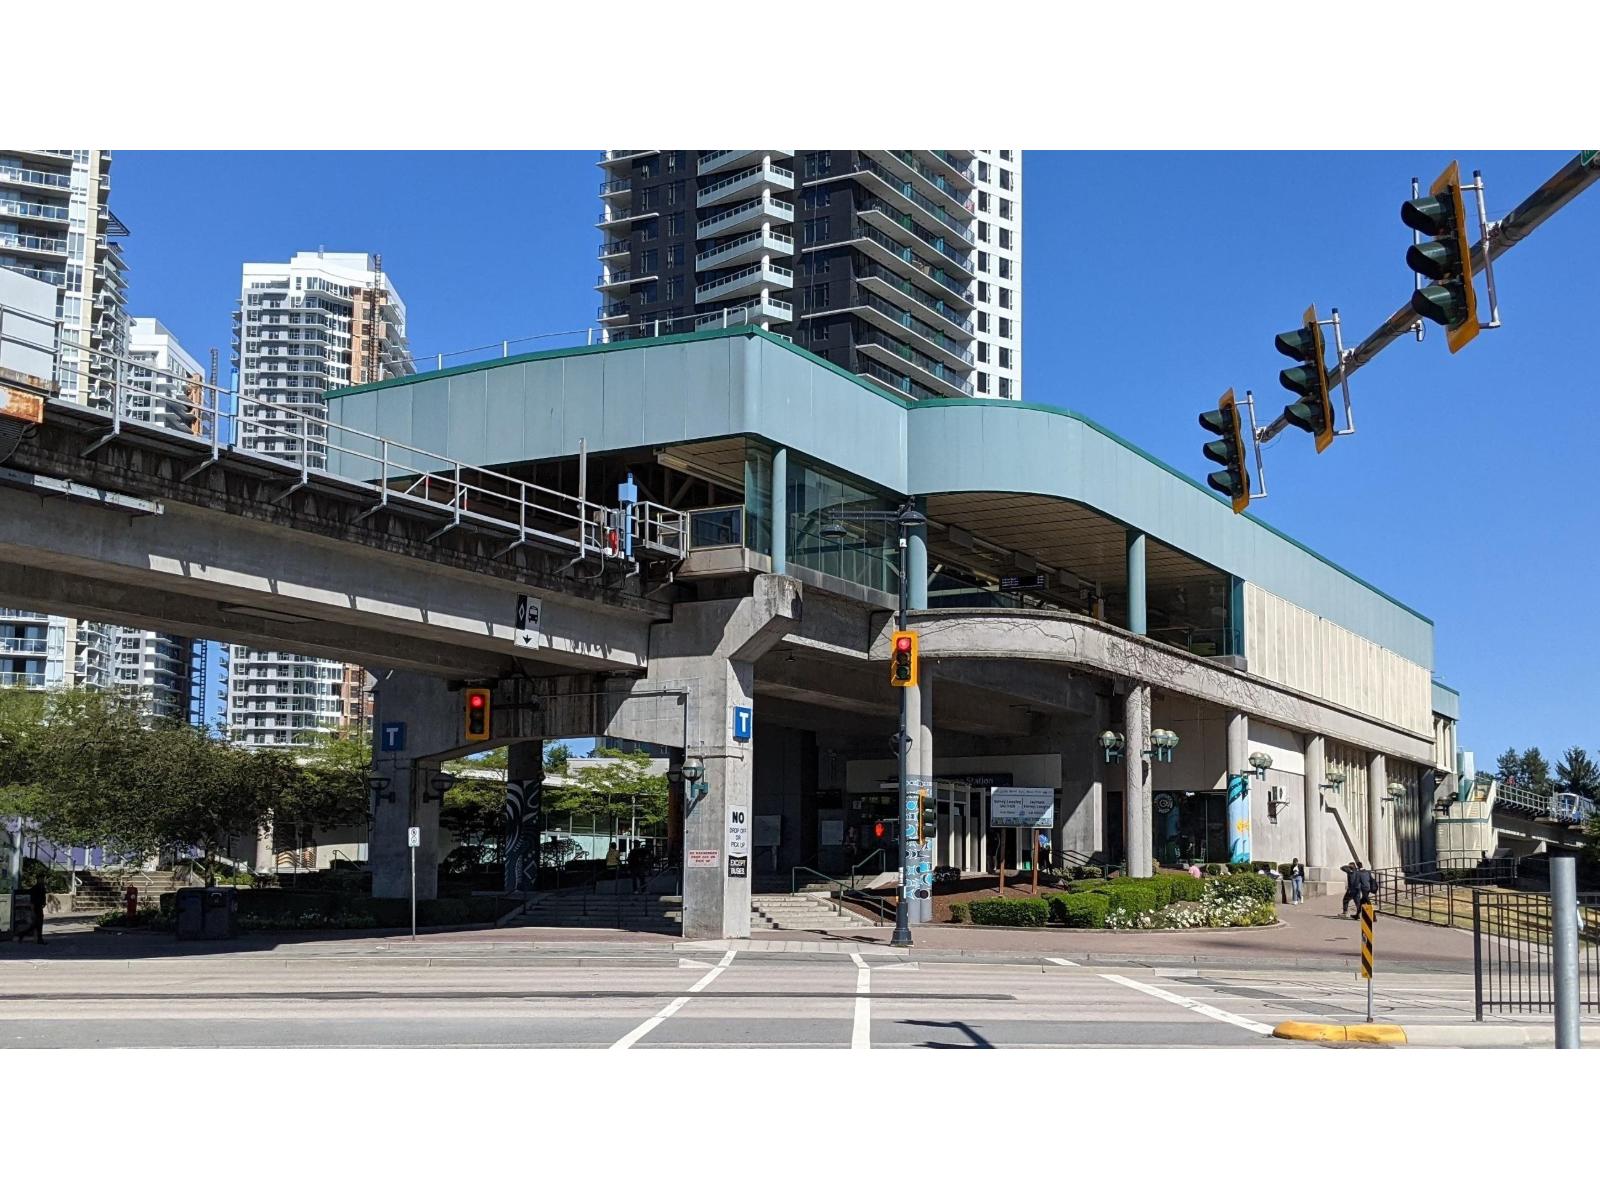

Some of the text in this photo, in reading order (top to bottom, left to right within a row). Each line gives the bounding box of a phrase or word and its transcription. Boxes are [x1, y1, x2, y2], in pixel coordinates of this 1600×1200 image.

[739, 711, 749, 733] T
[386, 727, 399, 746] T
[732, 811, 745, 824] NO
